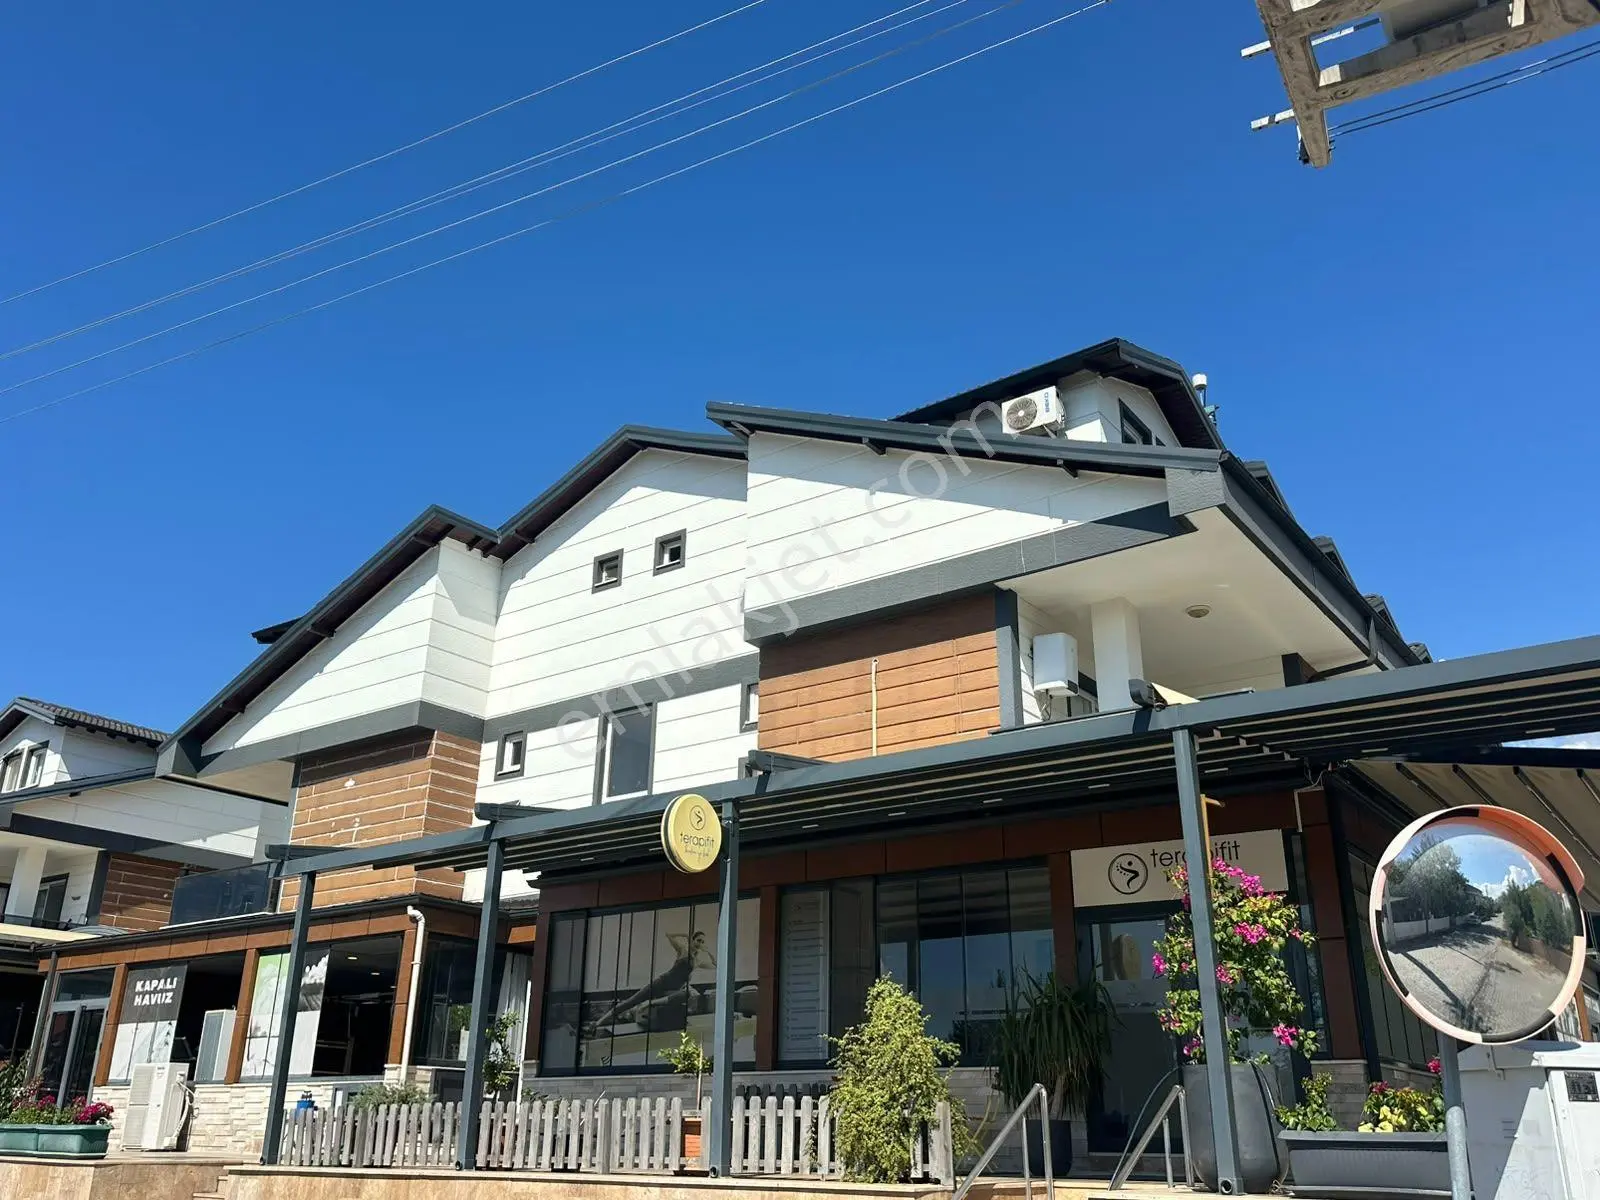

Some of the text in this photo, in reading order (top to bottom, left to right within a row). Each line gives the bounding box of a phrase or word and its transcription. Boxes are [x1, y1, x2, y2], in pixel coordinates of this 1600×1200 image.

[1150, 840, 1241, 868] terifit
[135, 977, 178, 992] KAPALI
[133, 991, 174, 1006] HAVUZ
